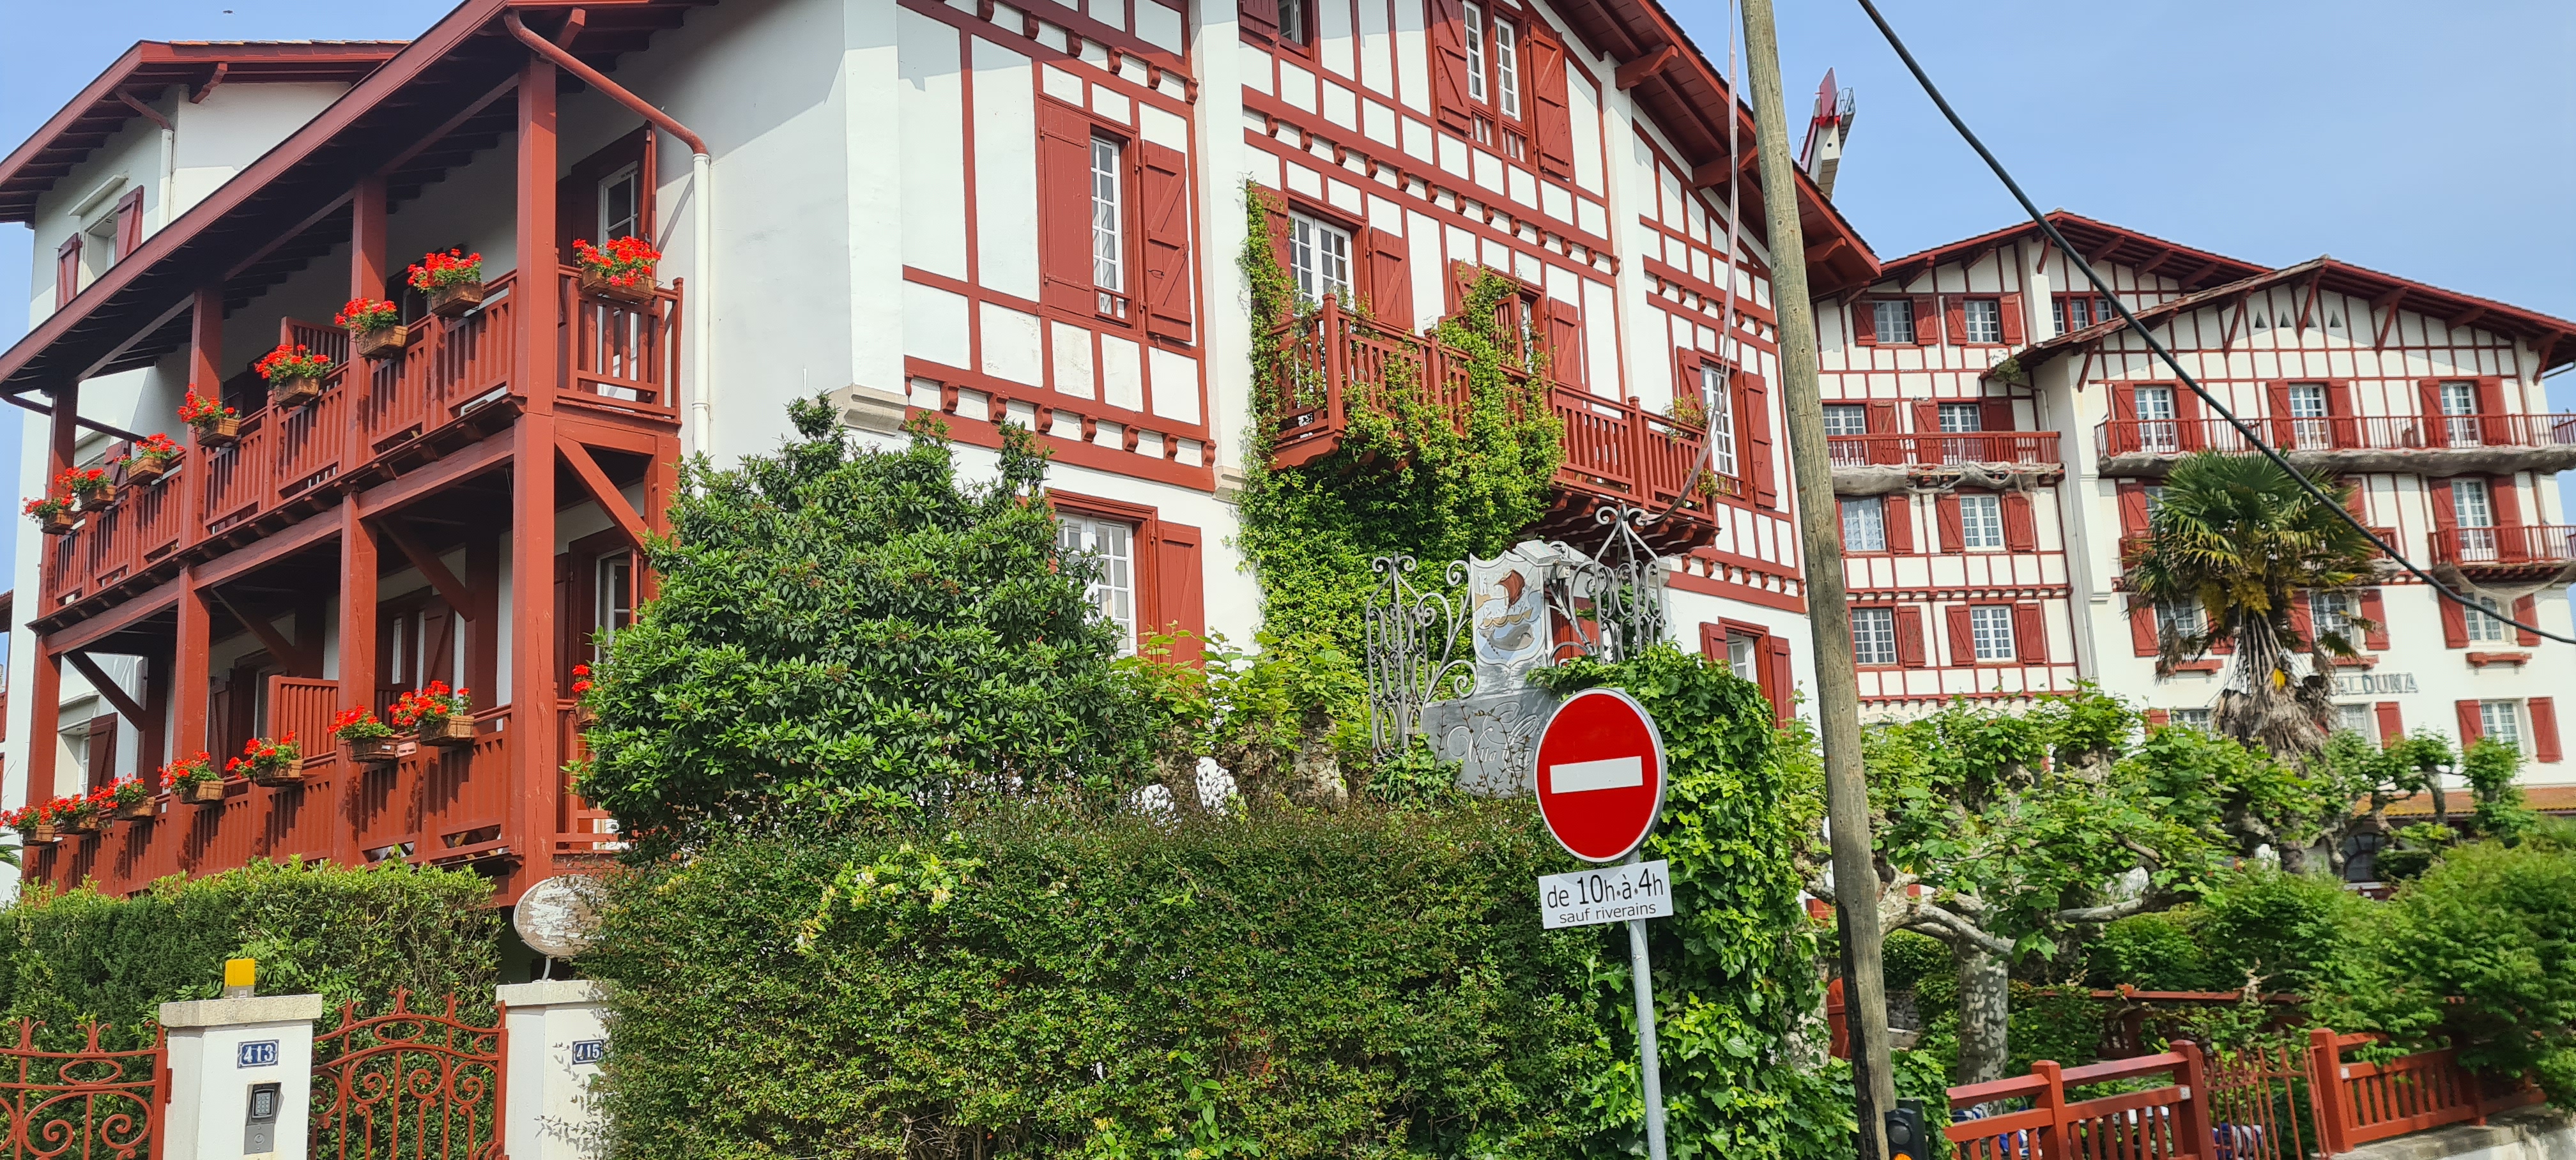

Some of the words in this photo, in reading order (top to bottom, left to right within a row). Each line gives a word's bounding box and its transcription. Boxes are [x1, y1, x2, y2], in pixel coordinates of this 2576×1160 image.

[1446, 724, 1497, 763] Villa
[1547, 885, 1570, 909] de
[1577, 874, 1616, 906] 10h
[1621, 874, 1632, 900] à
[1638, 867, 1664, 897] 4h
[1559, 908, 1591, 924] sauf
[1595, 903, 1657, 920] riverains
[243, 1044, 273, 1063] 413
[576, 1044, 600, 1060] 415
